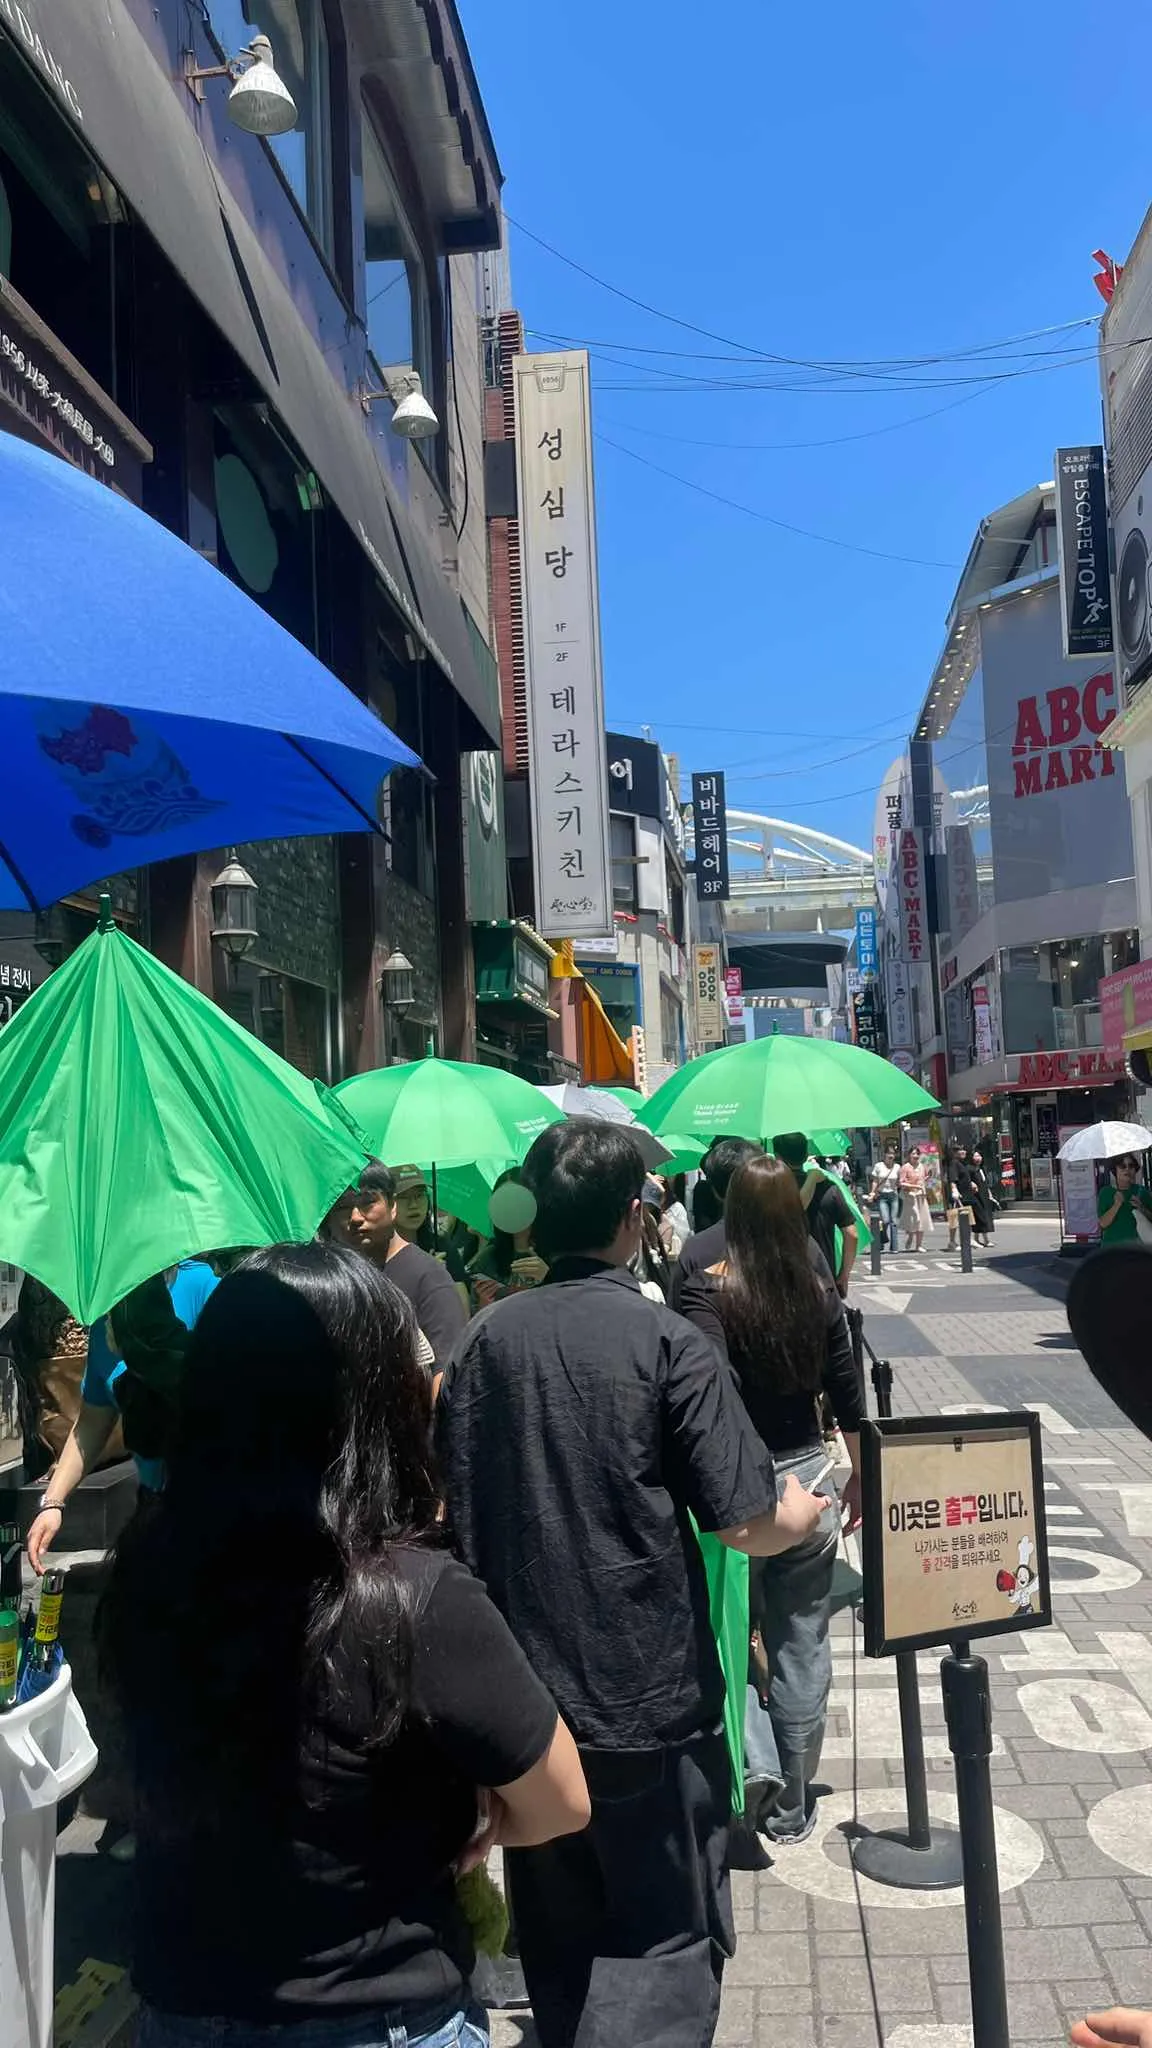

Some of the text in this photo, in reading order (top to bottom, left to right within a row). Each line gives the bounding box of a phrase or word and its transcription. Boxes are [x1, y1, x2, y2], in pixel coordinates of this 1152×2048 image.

[0, 329, 25, 372] 956
[537, 427, 574, 578] 성심당
[1074, 478, 1093, 550] ESCAPE
[1077, 553, 1098, 605] TOP
[555, 622, 567, 633] 1F
[555, 652, 569, 662] 2F
[1096, 639, 1111, 648] 3F
[1011, 671, 1117, 756] ABC
[1013, 739, 1115, 799] MART
[703, 880, 723, 893] 3F
[12, 966, 31, 991] 전시
[698, 971, 707, 998] ODD
[888, 1490, 1028, 1532] 이곳은 출구입니다.
[914, 1529, 1009, 1555] 나가시는 분들을 배려하여
[934, 1553, 959, 1572] 간격을
